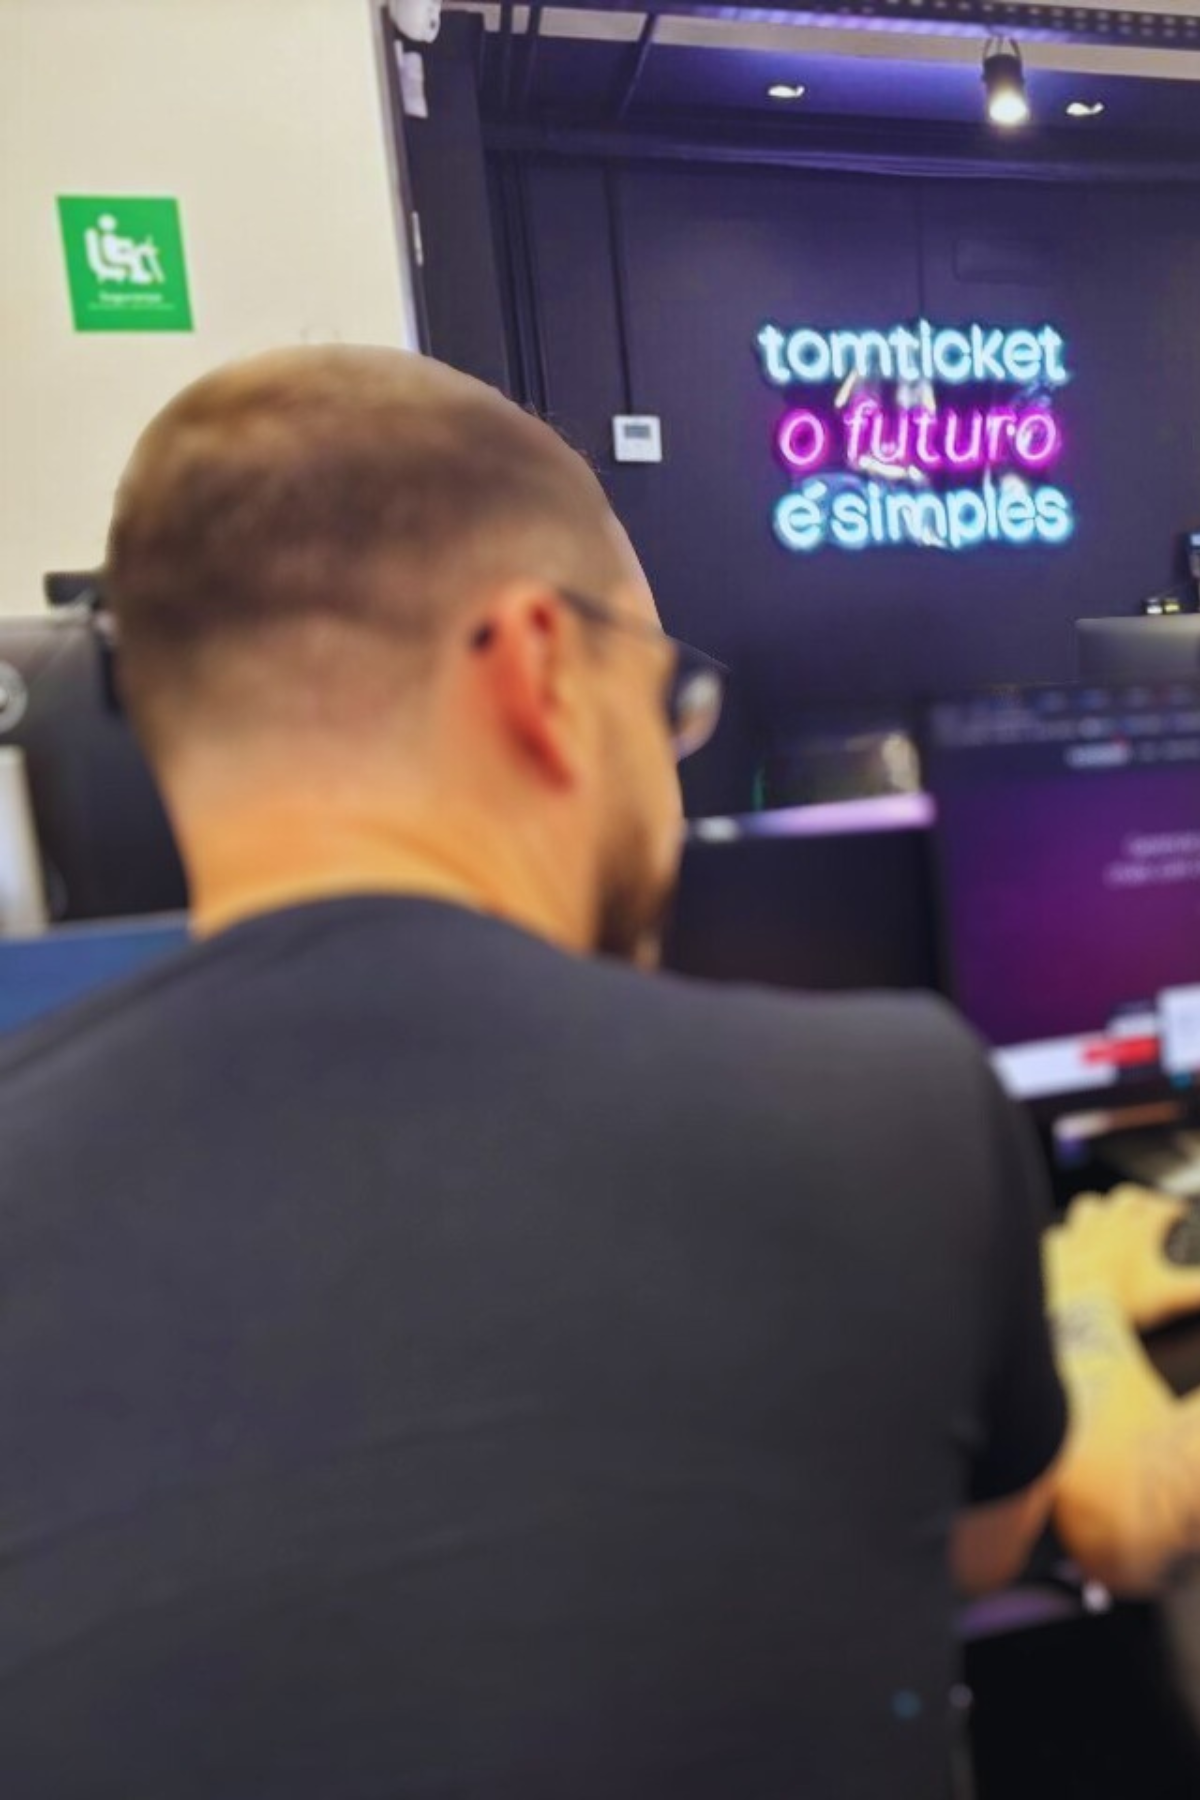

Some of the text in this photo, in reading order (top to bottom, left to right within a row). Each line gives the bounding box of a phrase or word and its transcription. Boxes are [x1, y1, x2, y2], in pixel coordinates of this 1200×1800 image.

[757, 318, 1070, 382] tomticket
[778, 398, 1060, 468] o futuro
[774, 472, 1070, 549] é simples
